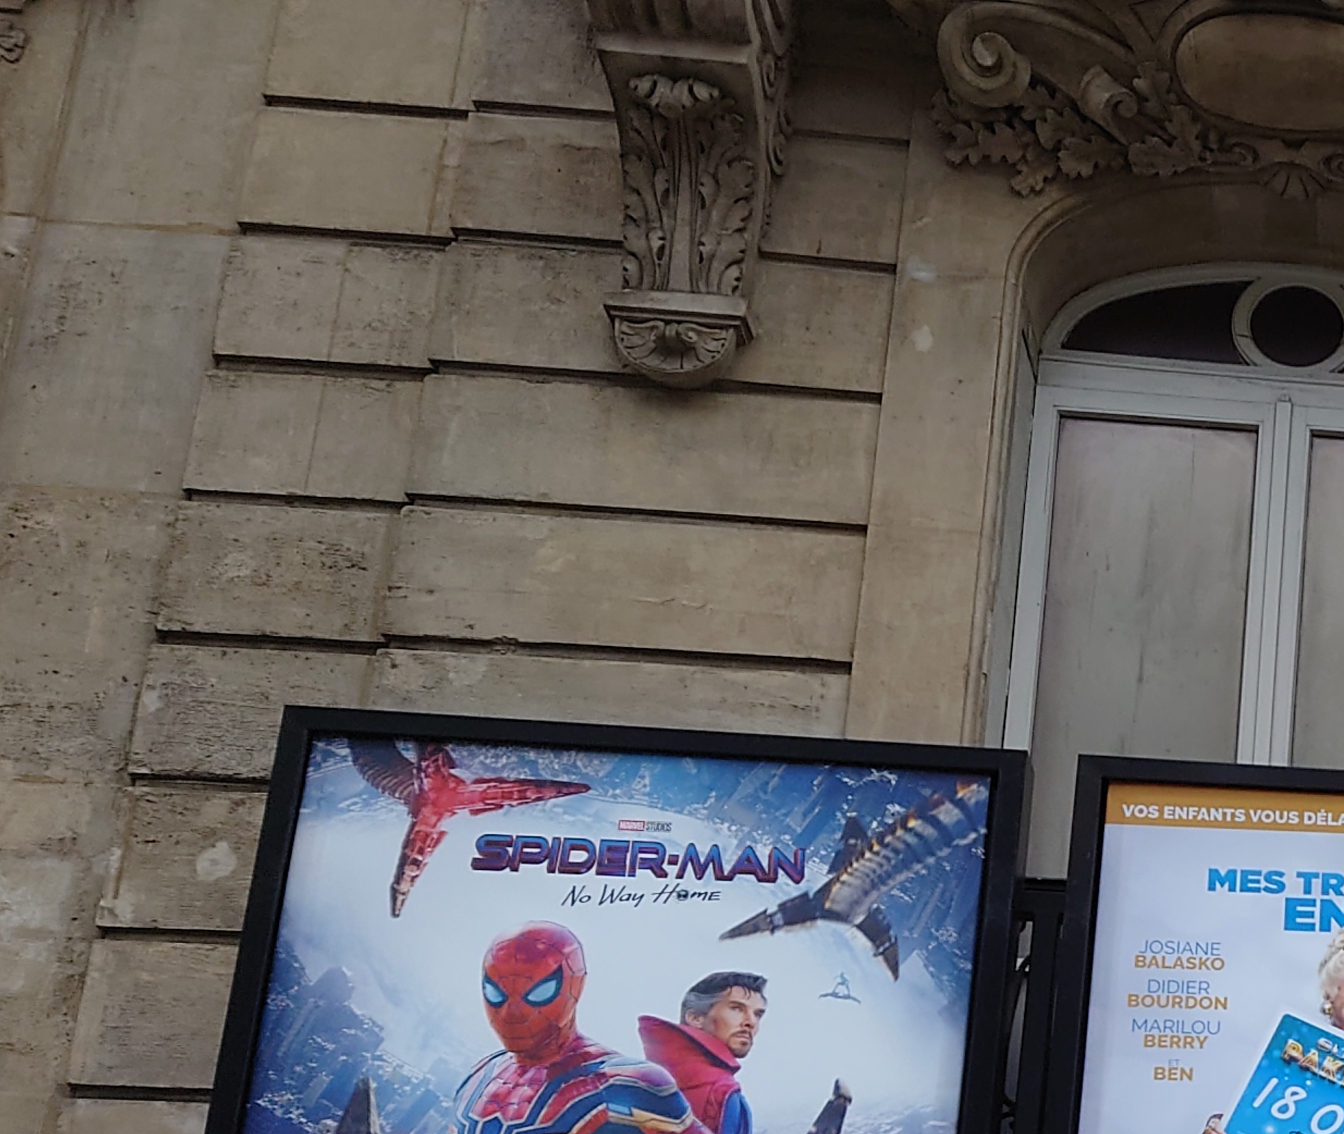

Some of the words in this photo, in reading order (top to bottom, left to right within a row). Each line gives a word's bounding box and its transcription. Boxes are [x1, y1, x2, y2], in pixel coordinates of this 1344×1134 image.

[1122, 804, 1159, 819] VOS
[1163, 806, 1246, 822] ENFANTS
[1249, 809, 1300, 825] VOUS
[618, 820, 645, 831] MARVEL
[645, 822, 672, 832] STUDIOS
[471, 834, 805, 884] SPIDER-MAN
[1207, 868, 1286, 893] MES
[561, 885, 591, 907] No
[598, 884, 645, 907] Way
[1138, 940, 1221, 956] JOSIANE
[1134, 955, 1225, 971] BALASKO
[1147, 979, 1210, 995] DIDIER
[1127, 994, 1228, 1010] BOURDON
[1131, 1018, 1221, 1035] MARILOU
[1143, 1034, 1208, 1049] BERRY
[1154, 1066, 1194, 1081] BEN
[1252, 1077, 1308, 1120] 18
